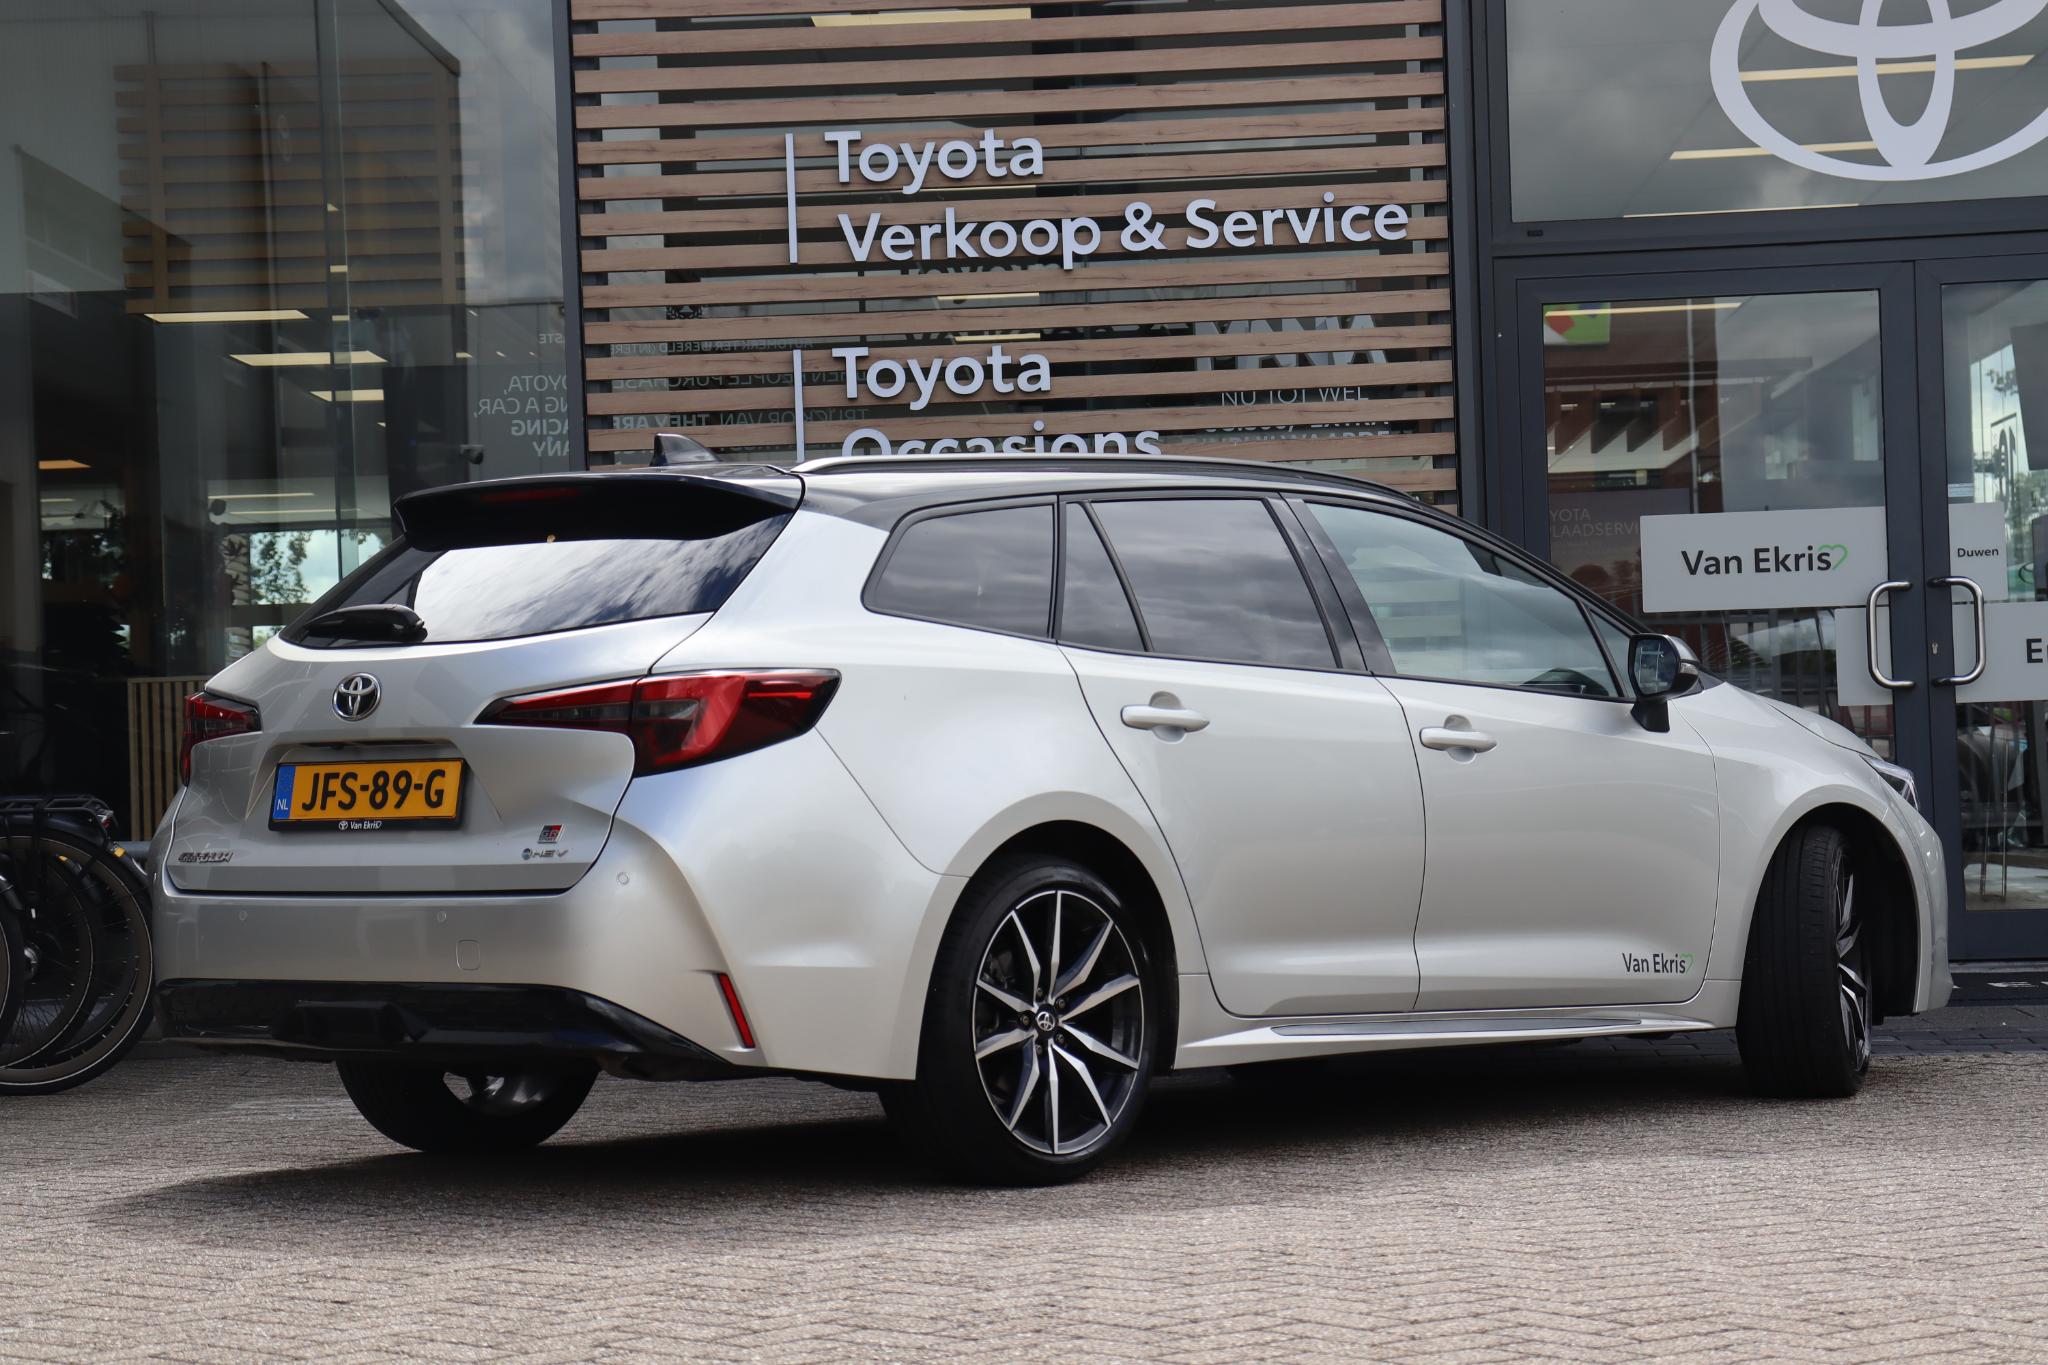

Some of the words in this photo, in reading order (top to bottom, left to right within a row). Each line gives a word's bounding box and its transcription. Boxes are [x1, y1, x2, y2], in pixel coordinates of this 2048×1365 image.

[824, 129, 1044, 195] Toyota
[838, 206, 1101, 270] Verkoop
[1121, 202, 1166, 251] &
[1186, 193, 1409, 249] Service
[832, 345, 1051, 411] Toyota
[1681, 550, 1742, 576] Van
[1754, 545, 1832, 574] Ekris
[1957, 547, 1999, 558] Duwen
[2026, 638, 2048, 664] E
[302, 769, 445, 811] JFS-89-G
[276, 798, 289, 811] NL
[350, 821, 362, 830] Van
[1621, 952, 1649, 973] Van
[1652, 952, 1686, 974] Ekris
